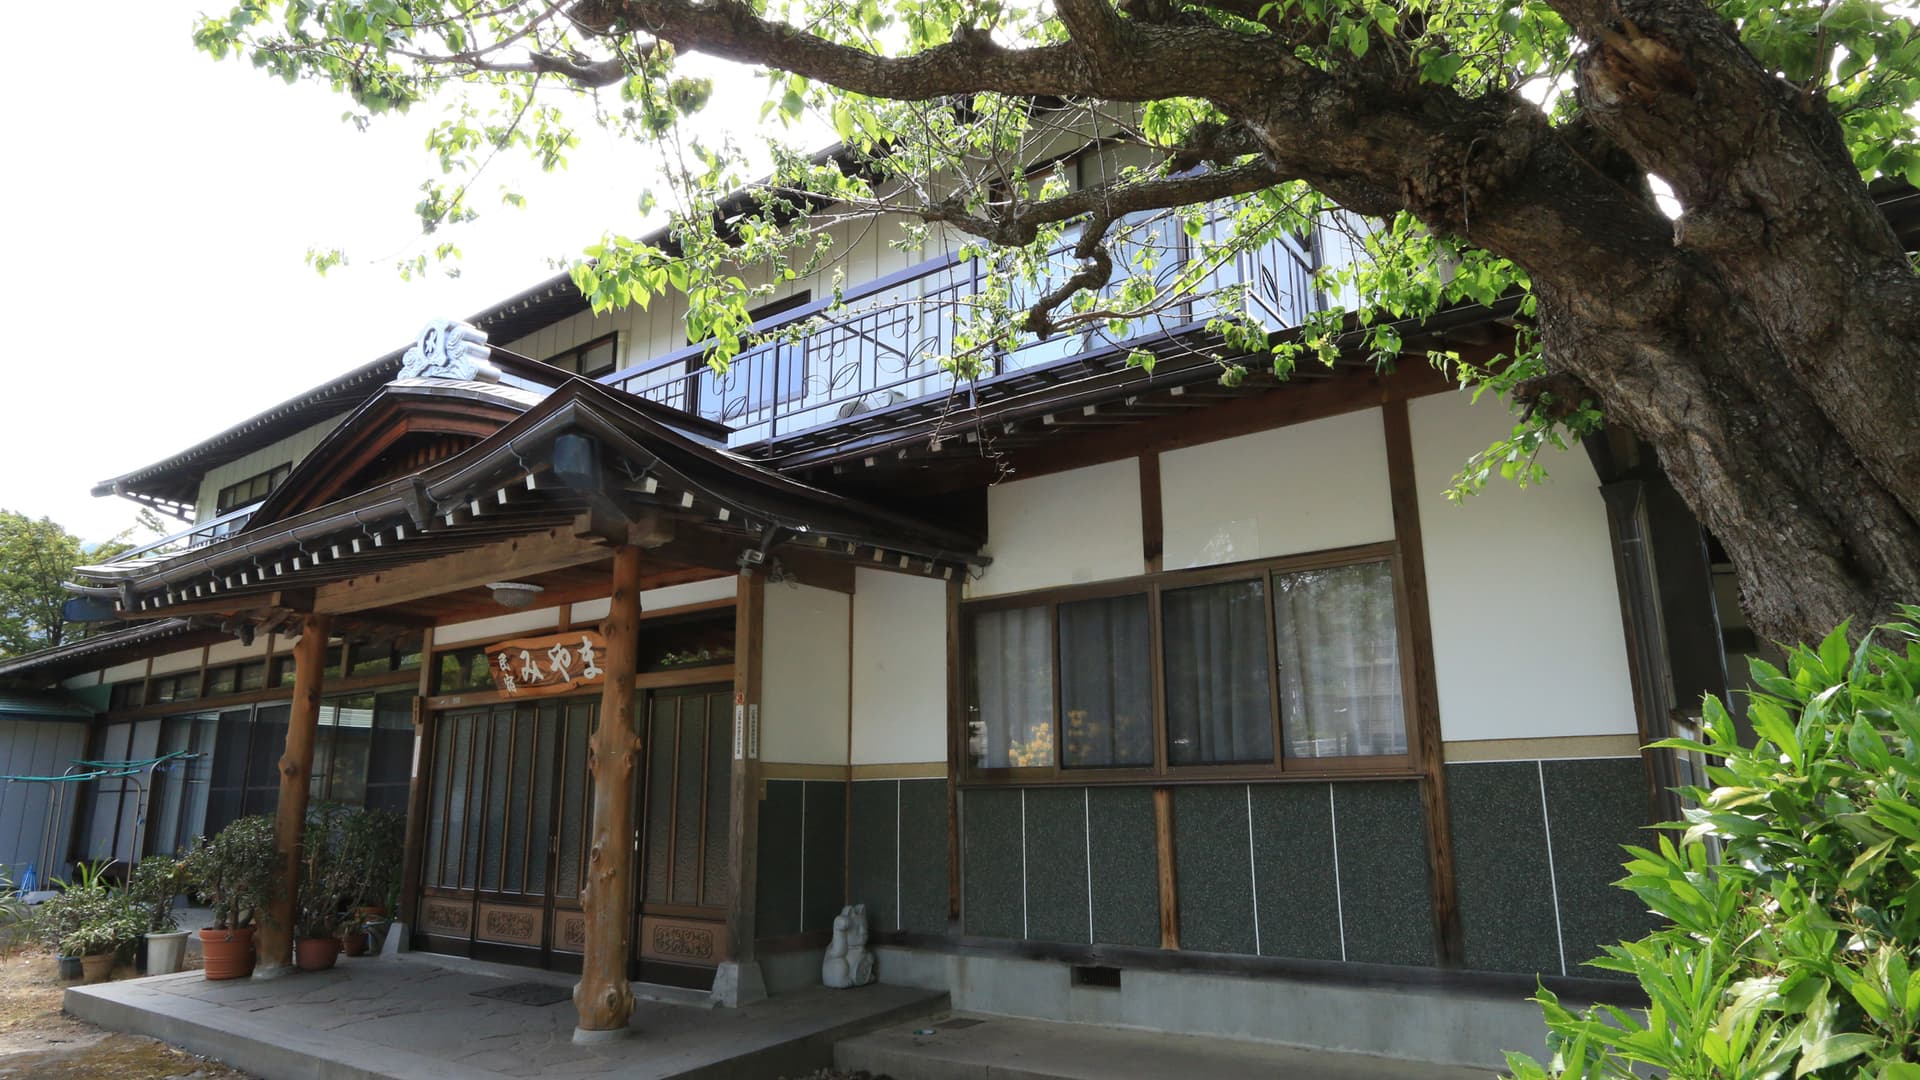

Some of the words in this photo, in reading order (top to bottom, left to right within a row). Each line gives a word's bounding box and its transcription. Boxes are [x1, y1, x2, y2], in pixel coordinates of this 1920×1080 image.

[497, 652, 517, 694] 民宿
[519, 635, 603, 684] みやま
